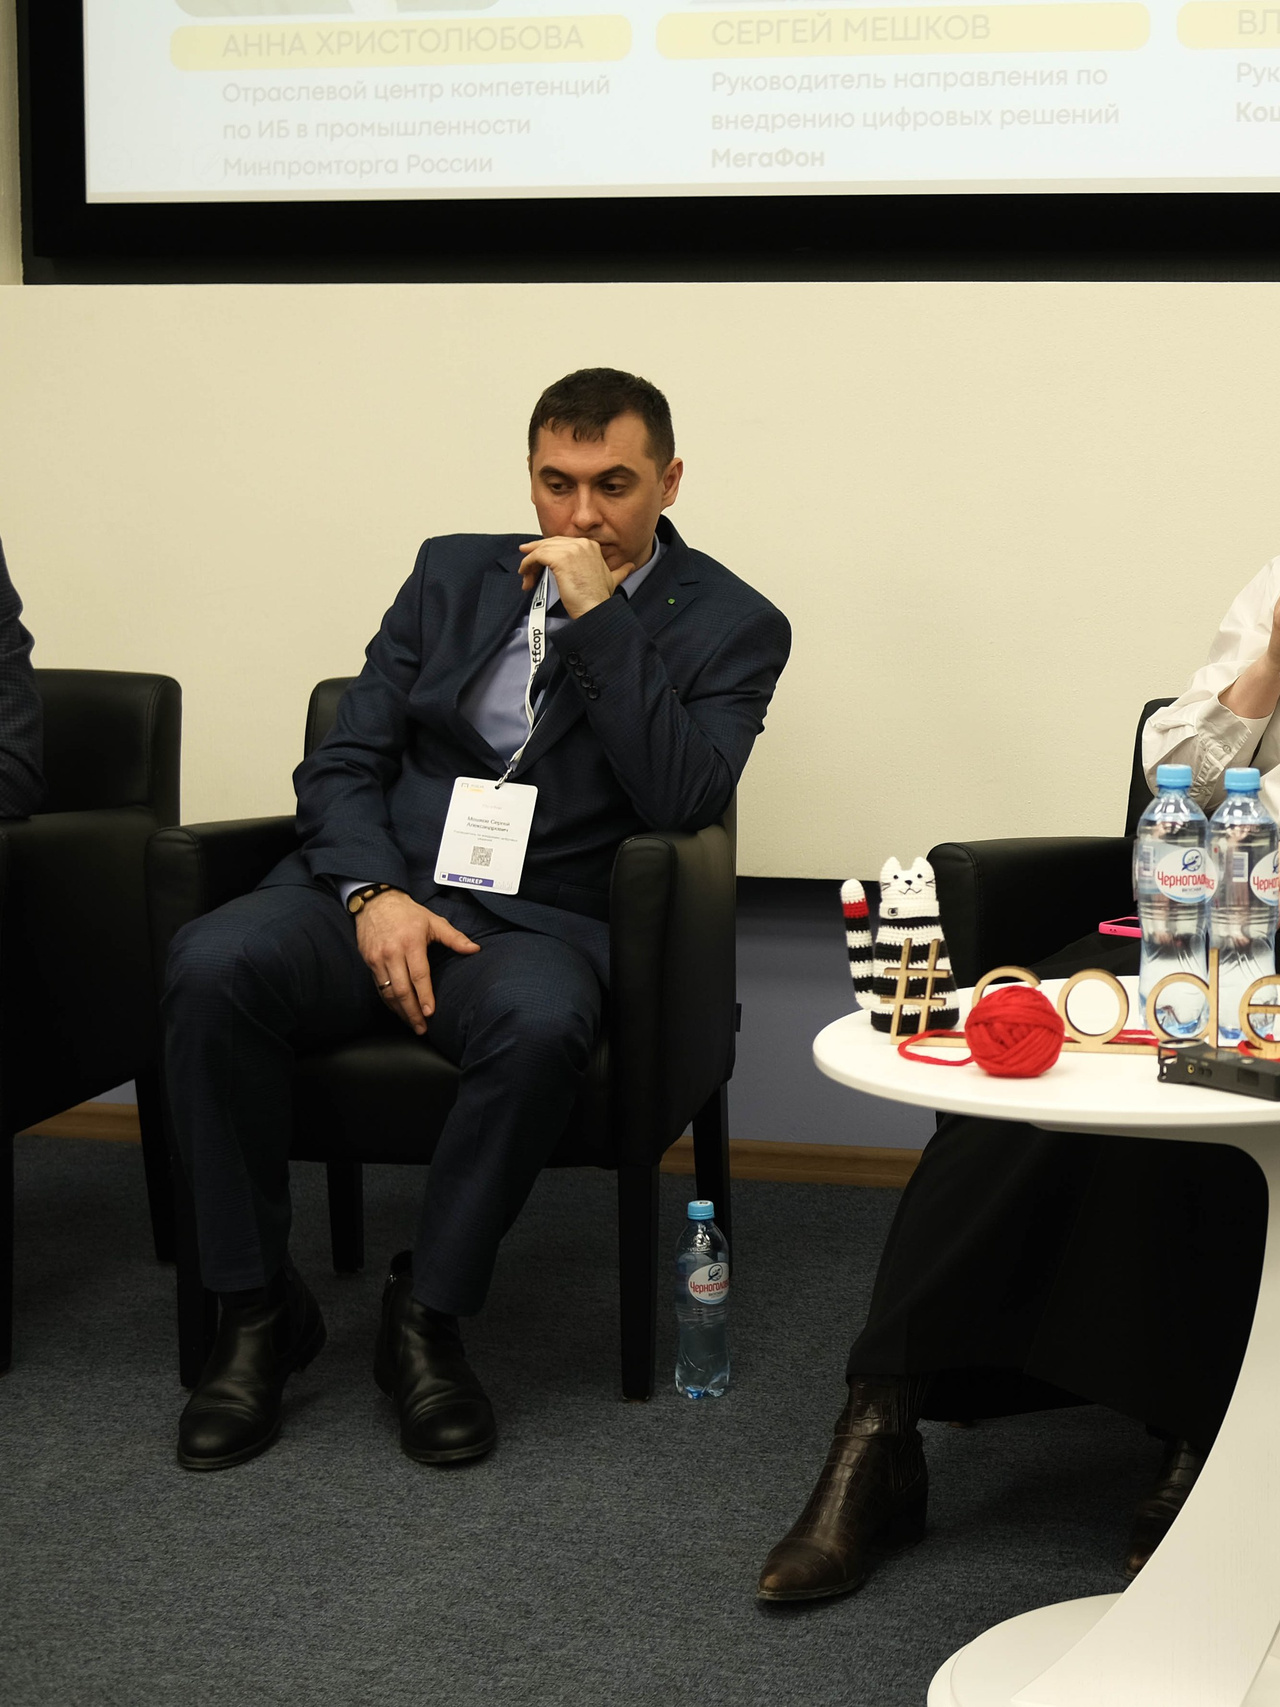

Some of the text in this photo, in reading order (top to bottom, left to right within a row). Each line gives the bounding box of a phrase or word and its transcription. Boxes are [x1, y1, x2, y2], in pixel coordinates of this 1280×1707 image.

[222, 25, 585, 58] АННА ХРИСТОЛЮБОВА
[712, 12, 991, 46] СЕРГЕЙ МЕШКОВ
[222, 74, 611, 103] Отраслевой центр компетенций
[712, 68, 1108, 96] Руководитель направления по
[223, 118, 530, 142] по ИБ в промышленности
[711, 103, 1120, 134] внедрению цифровых решений
[223, 153, 493, 180] Минпромторга России
[711, 147, 825, 168] МегаФон
[458, 876, 484, 885] СПИКЕР
